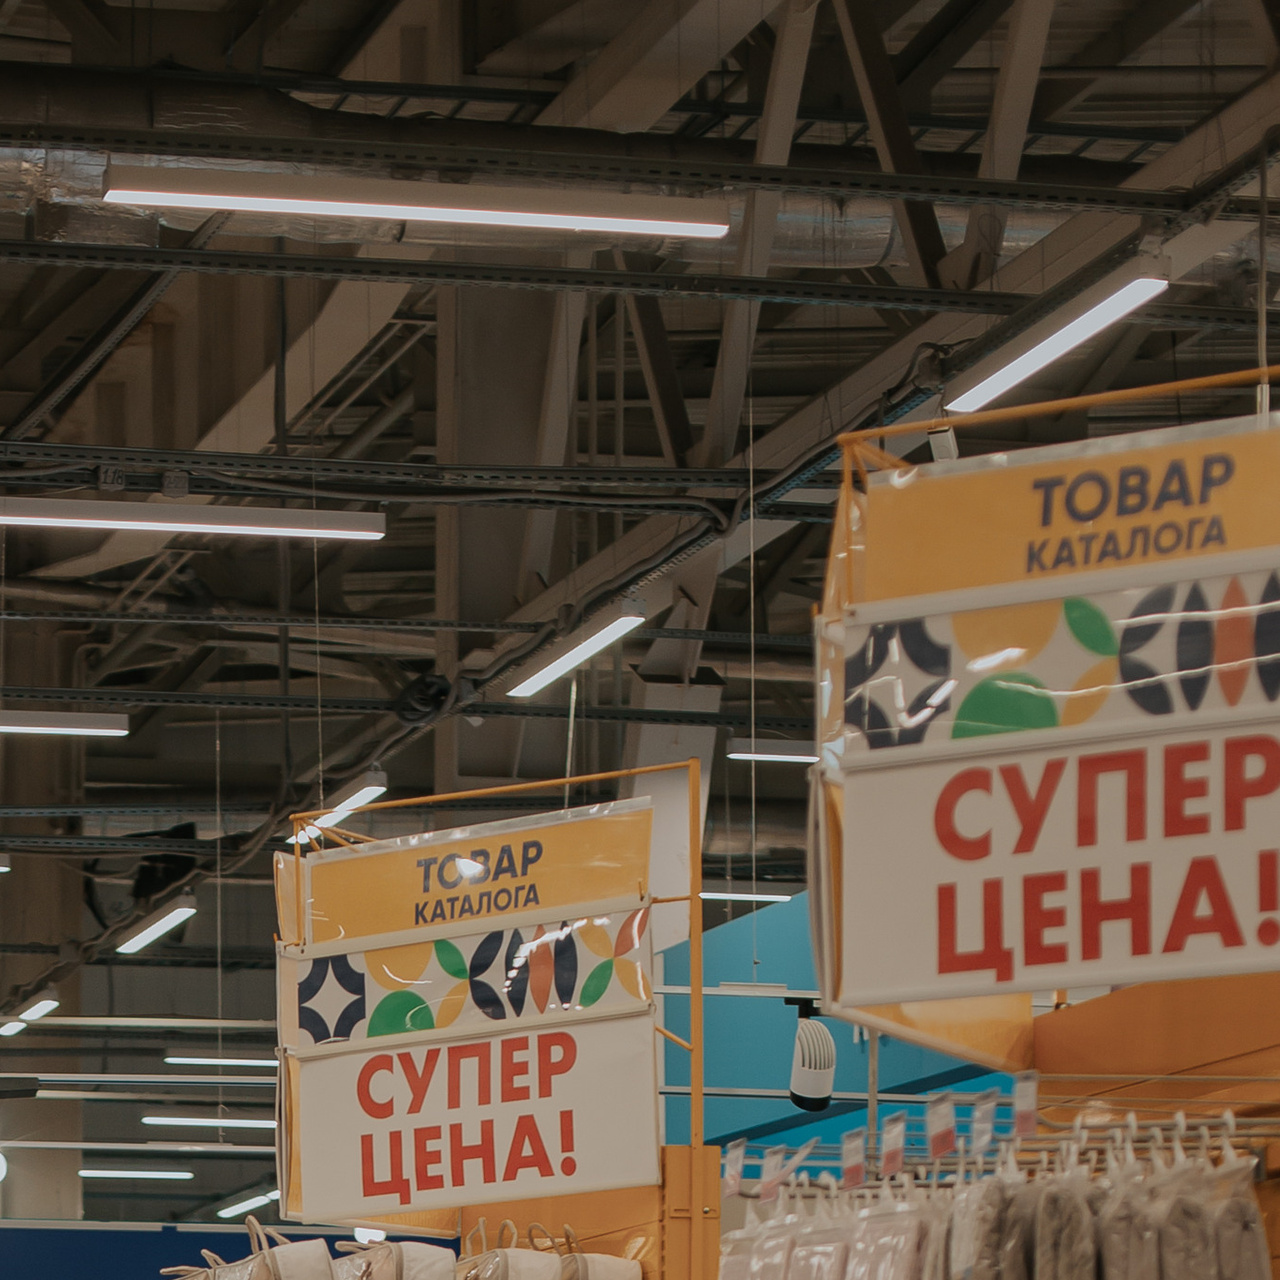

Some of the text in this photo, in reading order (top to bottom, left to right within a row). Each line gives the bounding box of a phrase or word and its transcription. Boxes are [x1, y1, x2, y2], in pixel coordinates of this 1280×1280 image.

[1033, 454, 1235, 526] ТОВАР
[1027, 515, 1228, 574] КАТАЛОГА
[934, 734, 1280, 861] СУПЕР
[414, 881, 541, 925] КАТАЛОГА
[416, 840, 544, 893] ТОВАР
[937, 848, 1280, 983] ЦЕНА!
[357, 1031, 578, 1120] СУПЕР
[361, 1109, 577, 1206] ЦЕНА!
